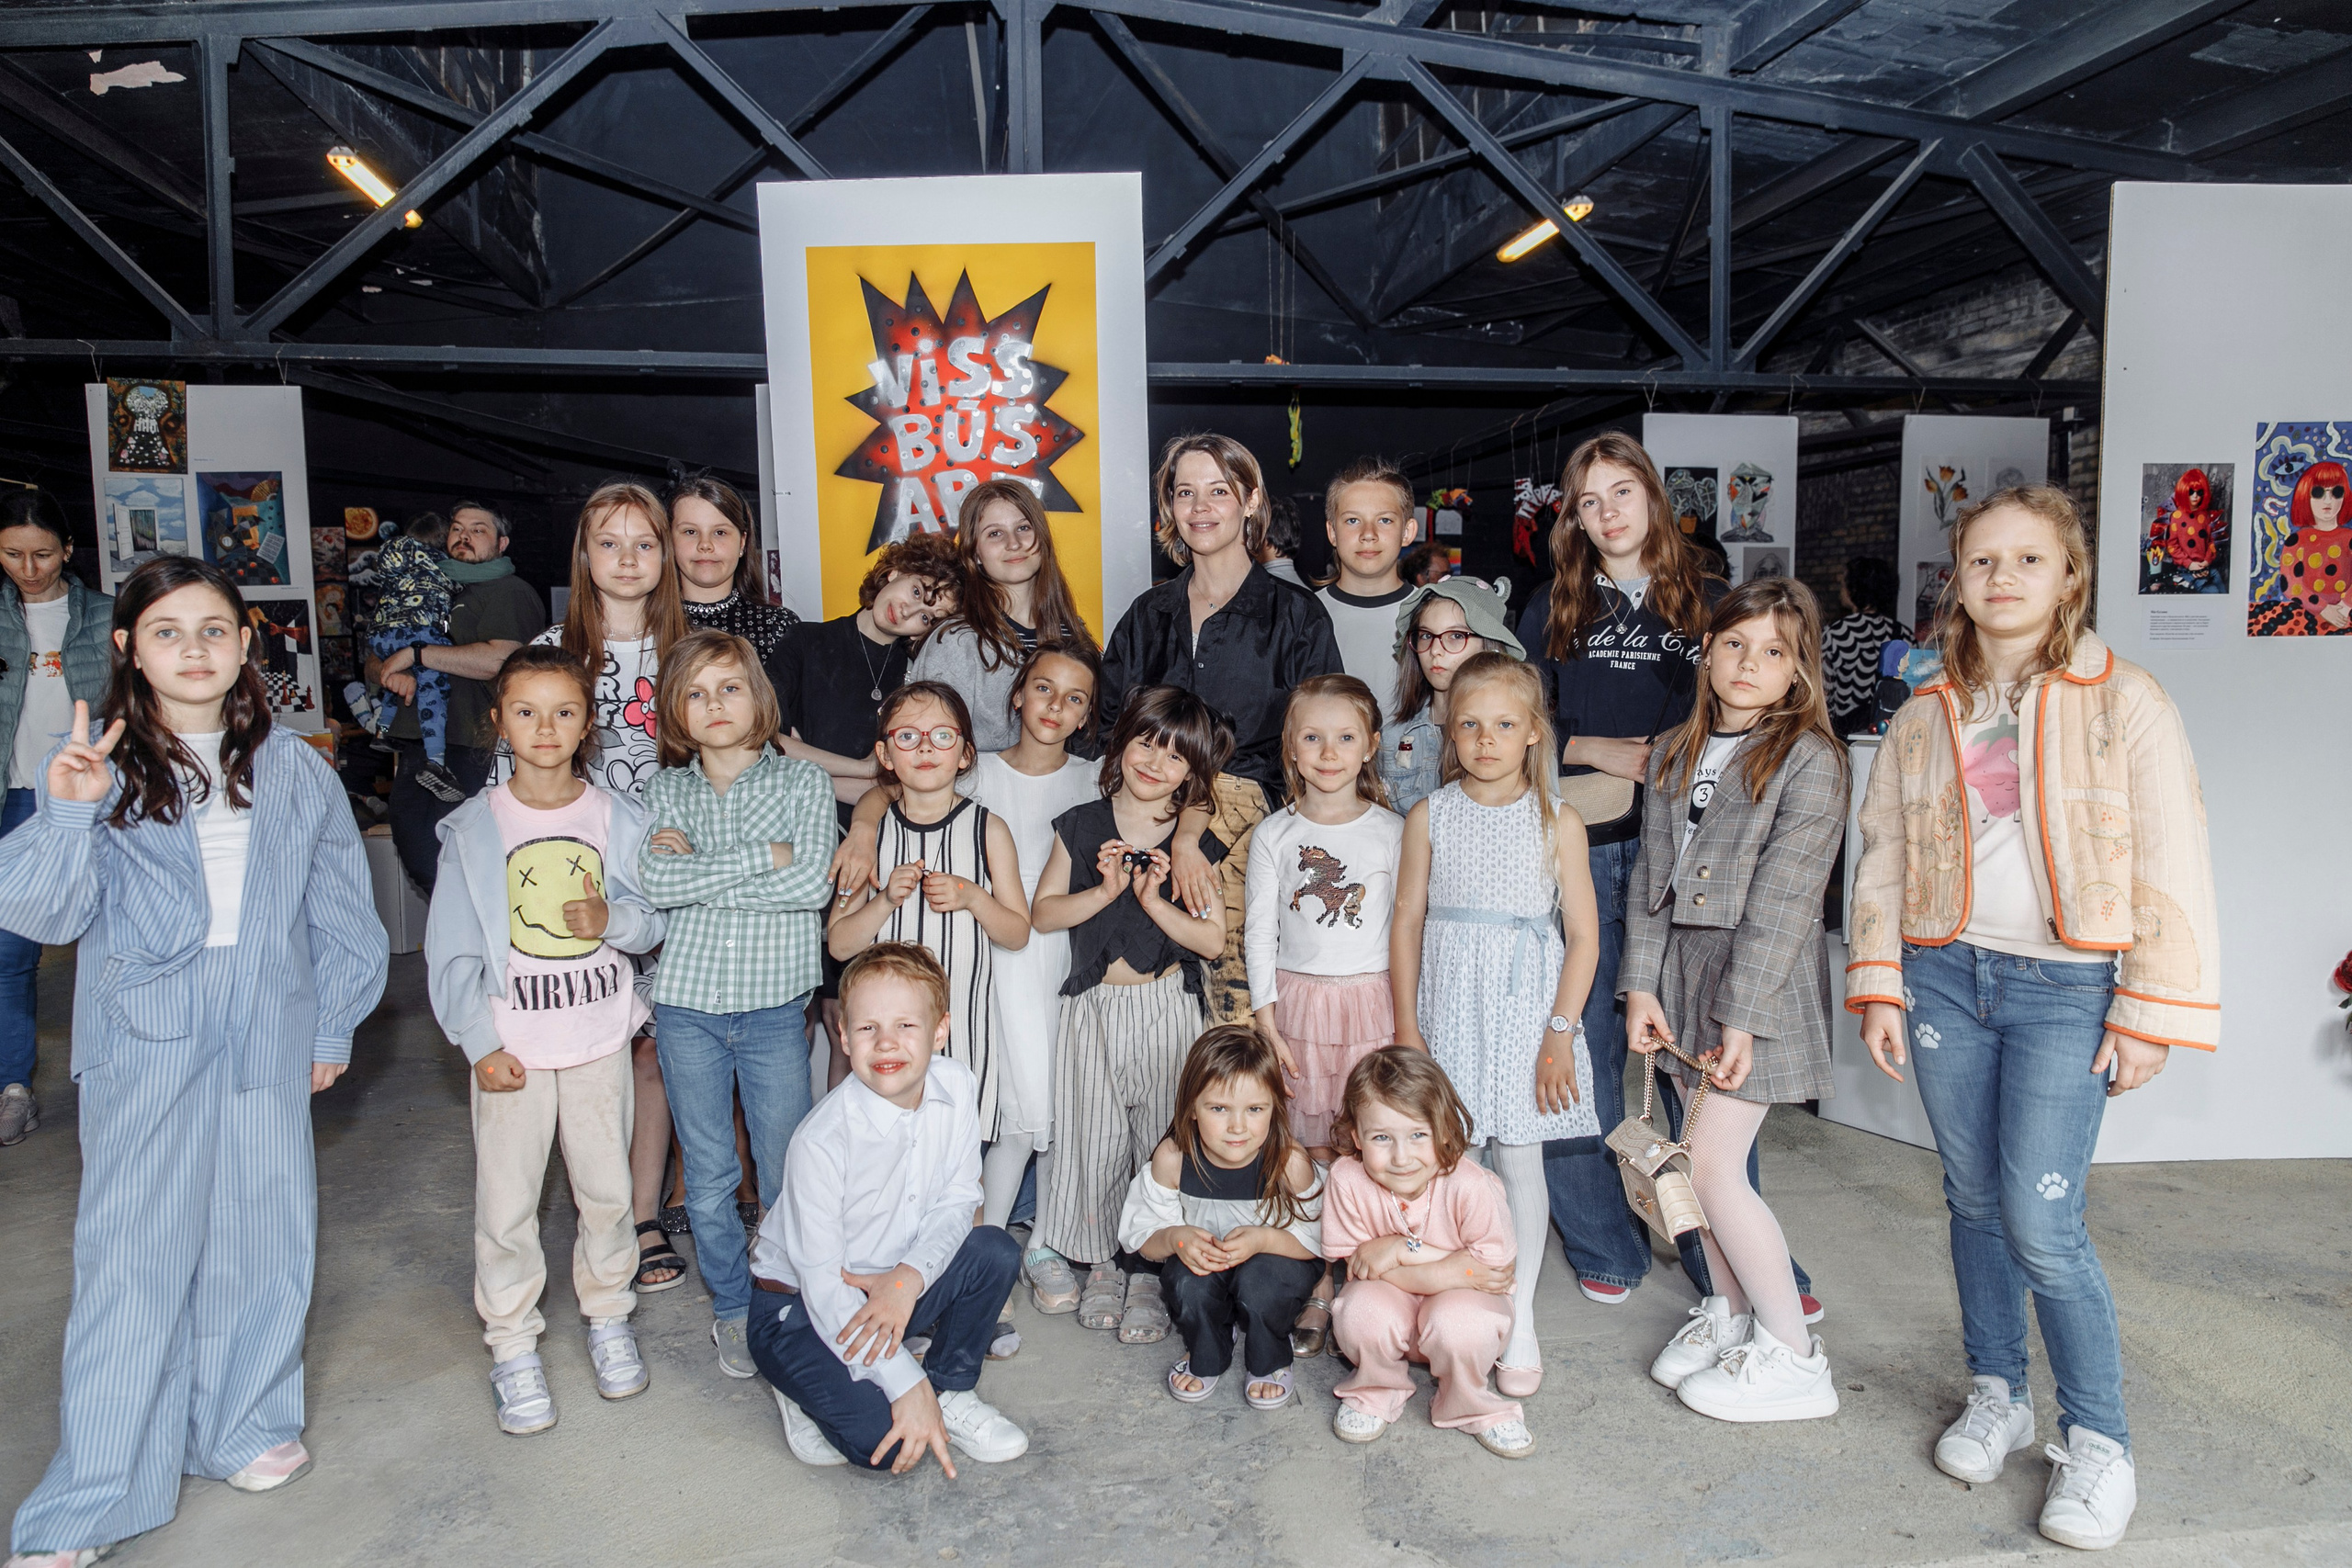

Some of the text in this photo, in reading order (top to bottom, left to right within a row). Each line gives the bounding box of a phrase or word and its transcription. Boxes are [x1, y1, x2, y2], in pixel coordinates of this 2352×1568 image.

[888, 400, 1038, 472] BŪS
[891, 469, 1044, 541] AR
[1588, 625, 1615, 648] de
[1623, 624, 1648, 649] la
[1589, 650, 1661, 661] ACADEMIE PARISIENNE
[1610, 660, 1636, 671] FRANCE
[511, 963, 618, 1010] NIRVANA
